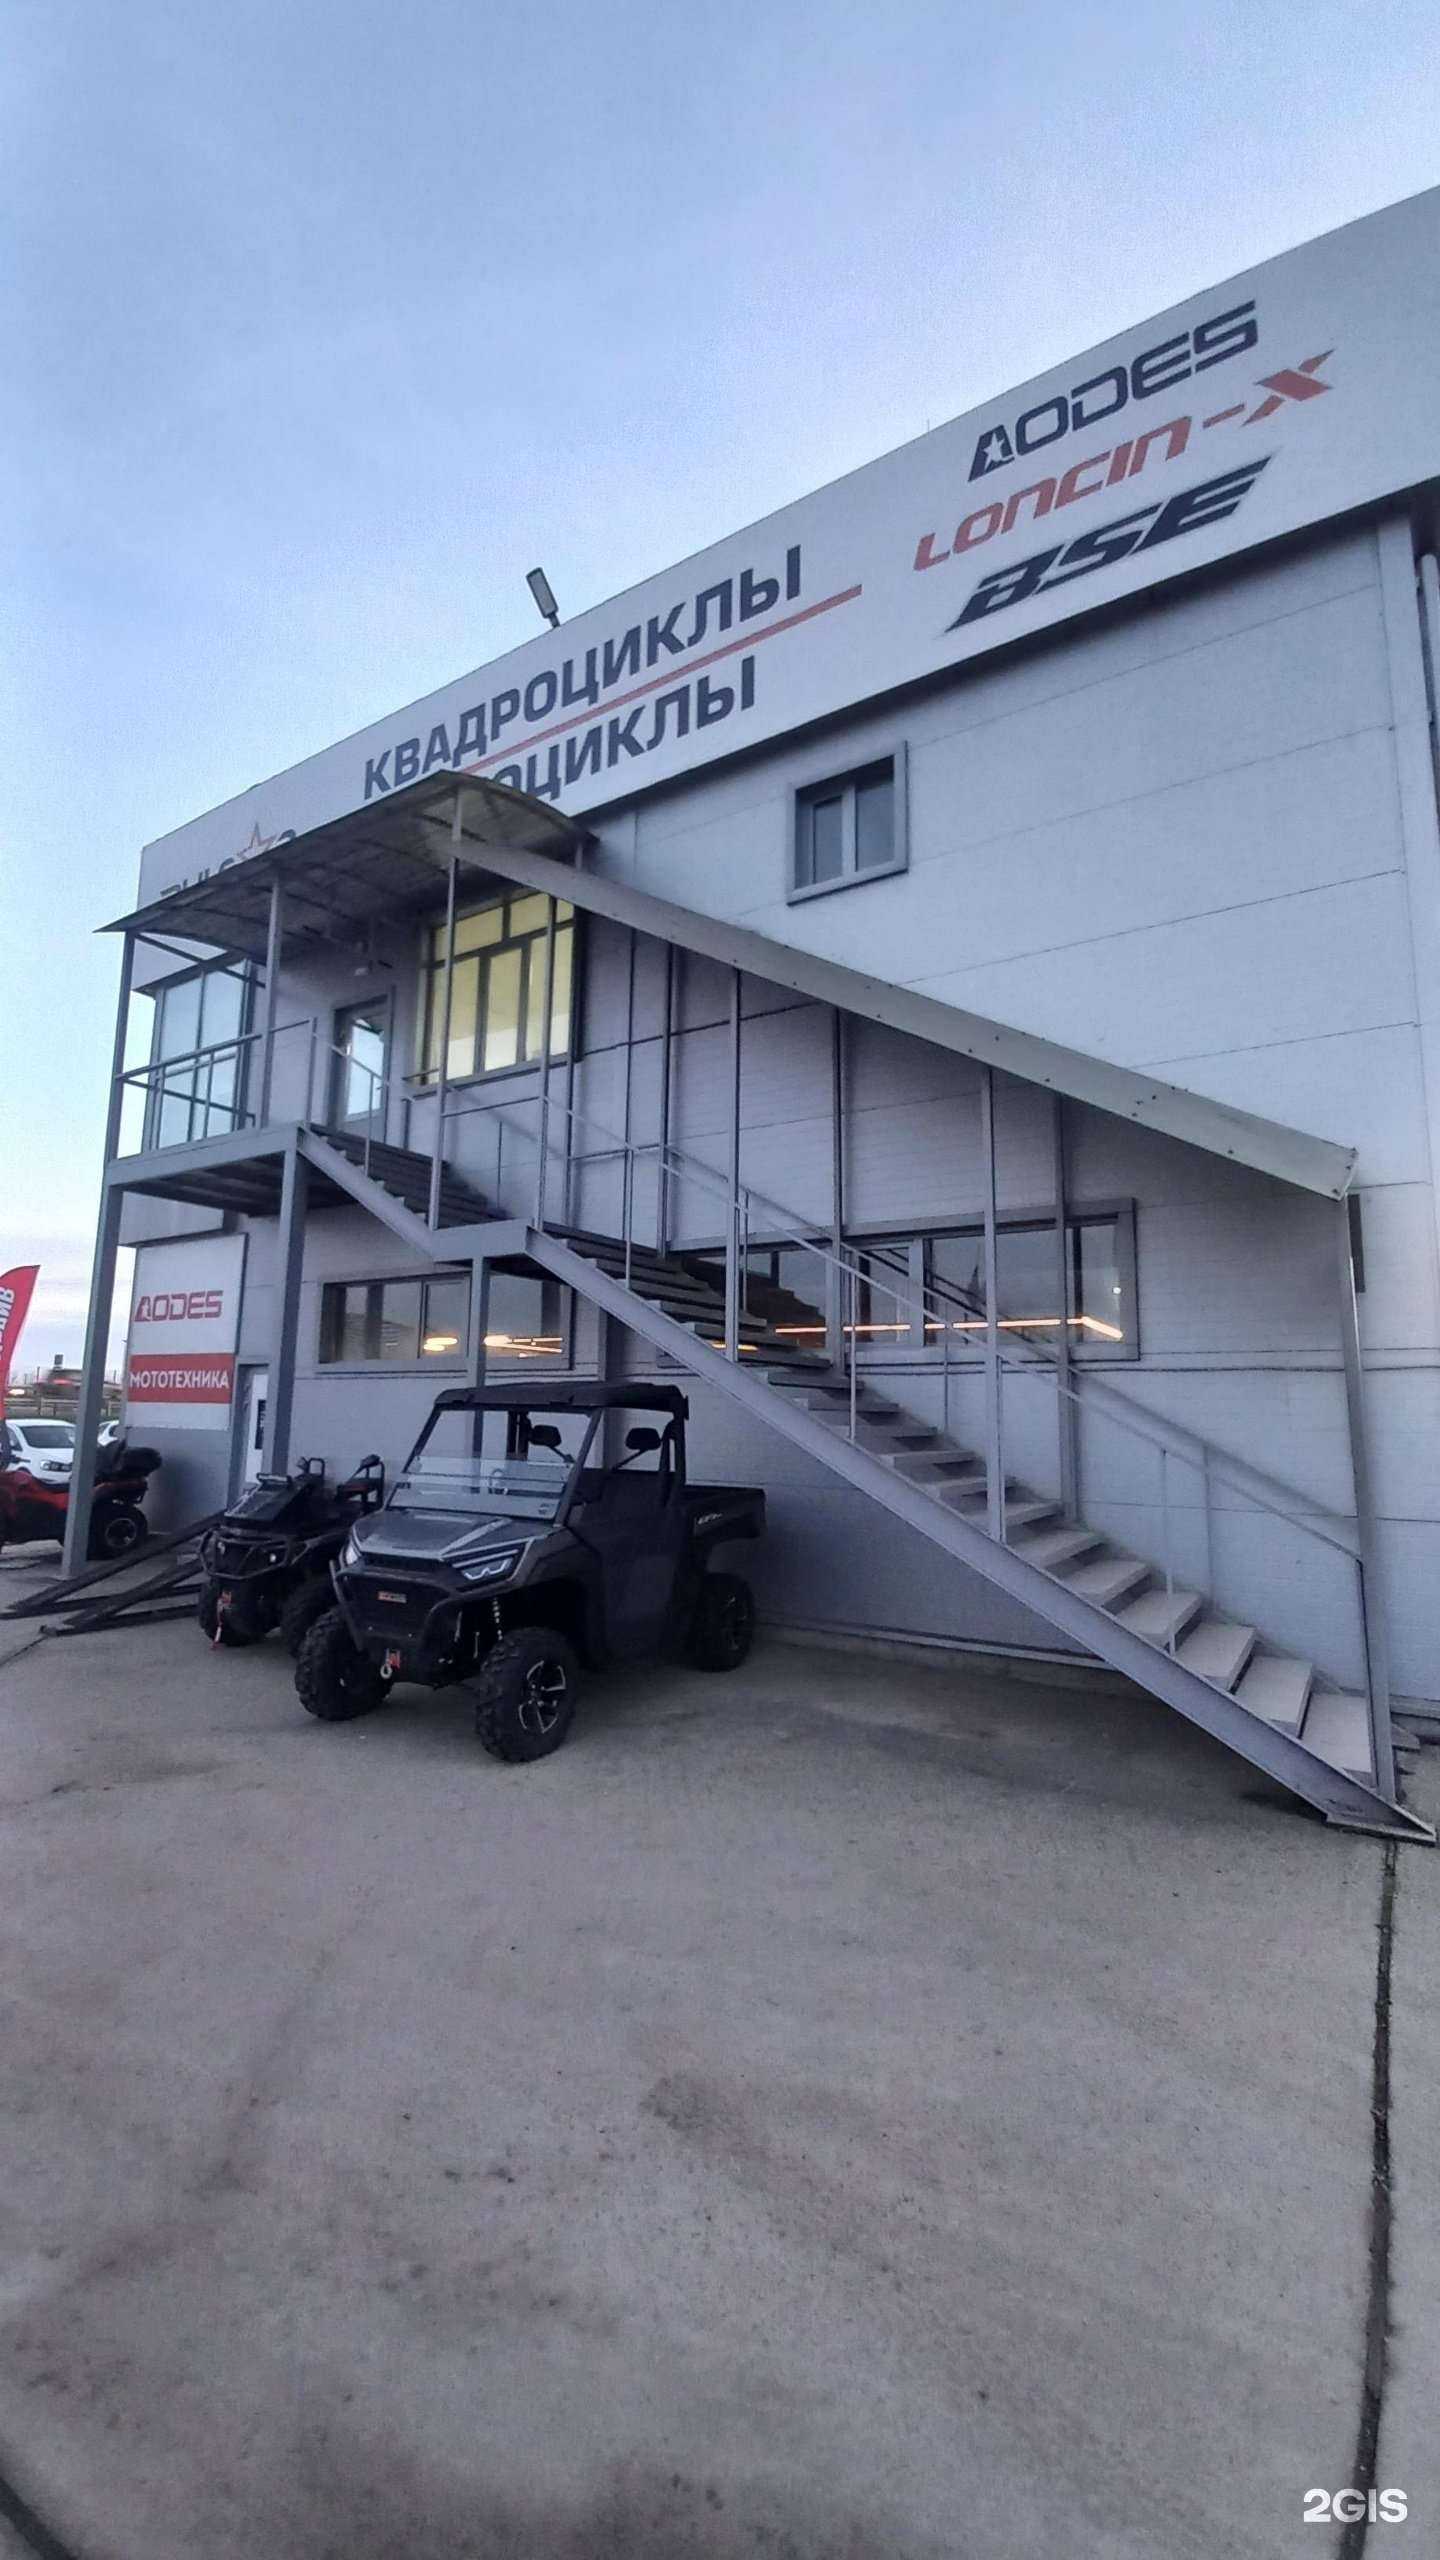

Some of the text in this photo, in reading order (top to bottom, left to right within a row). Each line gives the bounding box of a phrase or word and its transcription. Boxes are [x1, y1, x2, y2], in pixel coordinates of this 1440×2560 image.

[967, 300, 1259, 483] AODES
[943, 448, 1278, 634] BSE
[363, 544, 802, 800] КВАДРОЦИКЛЫ
[493, 654, 756, 802] ОЦИКЛЫ
[129, 1369, 230, 1389] МОТОТЕХНИКА
[134, 1289, 224, 1323] AODES
